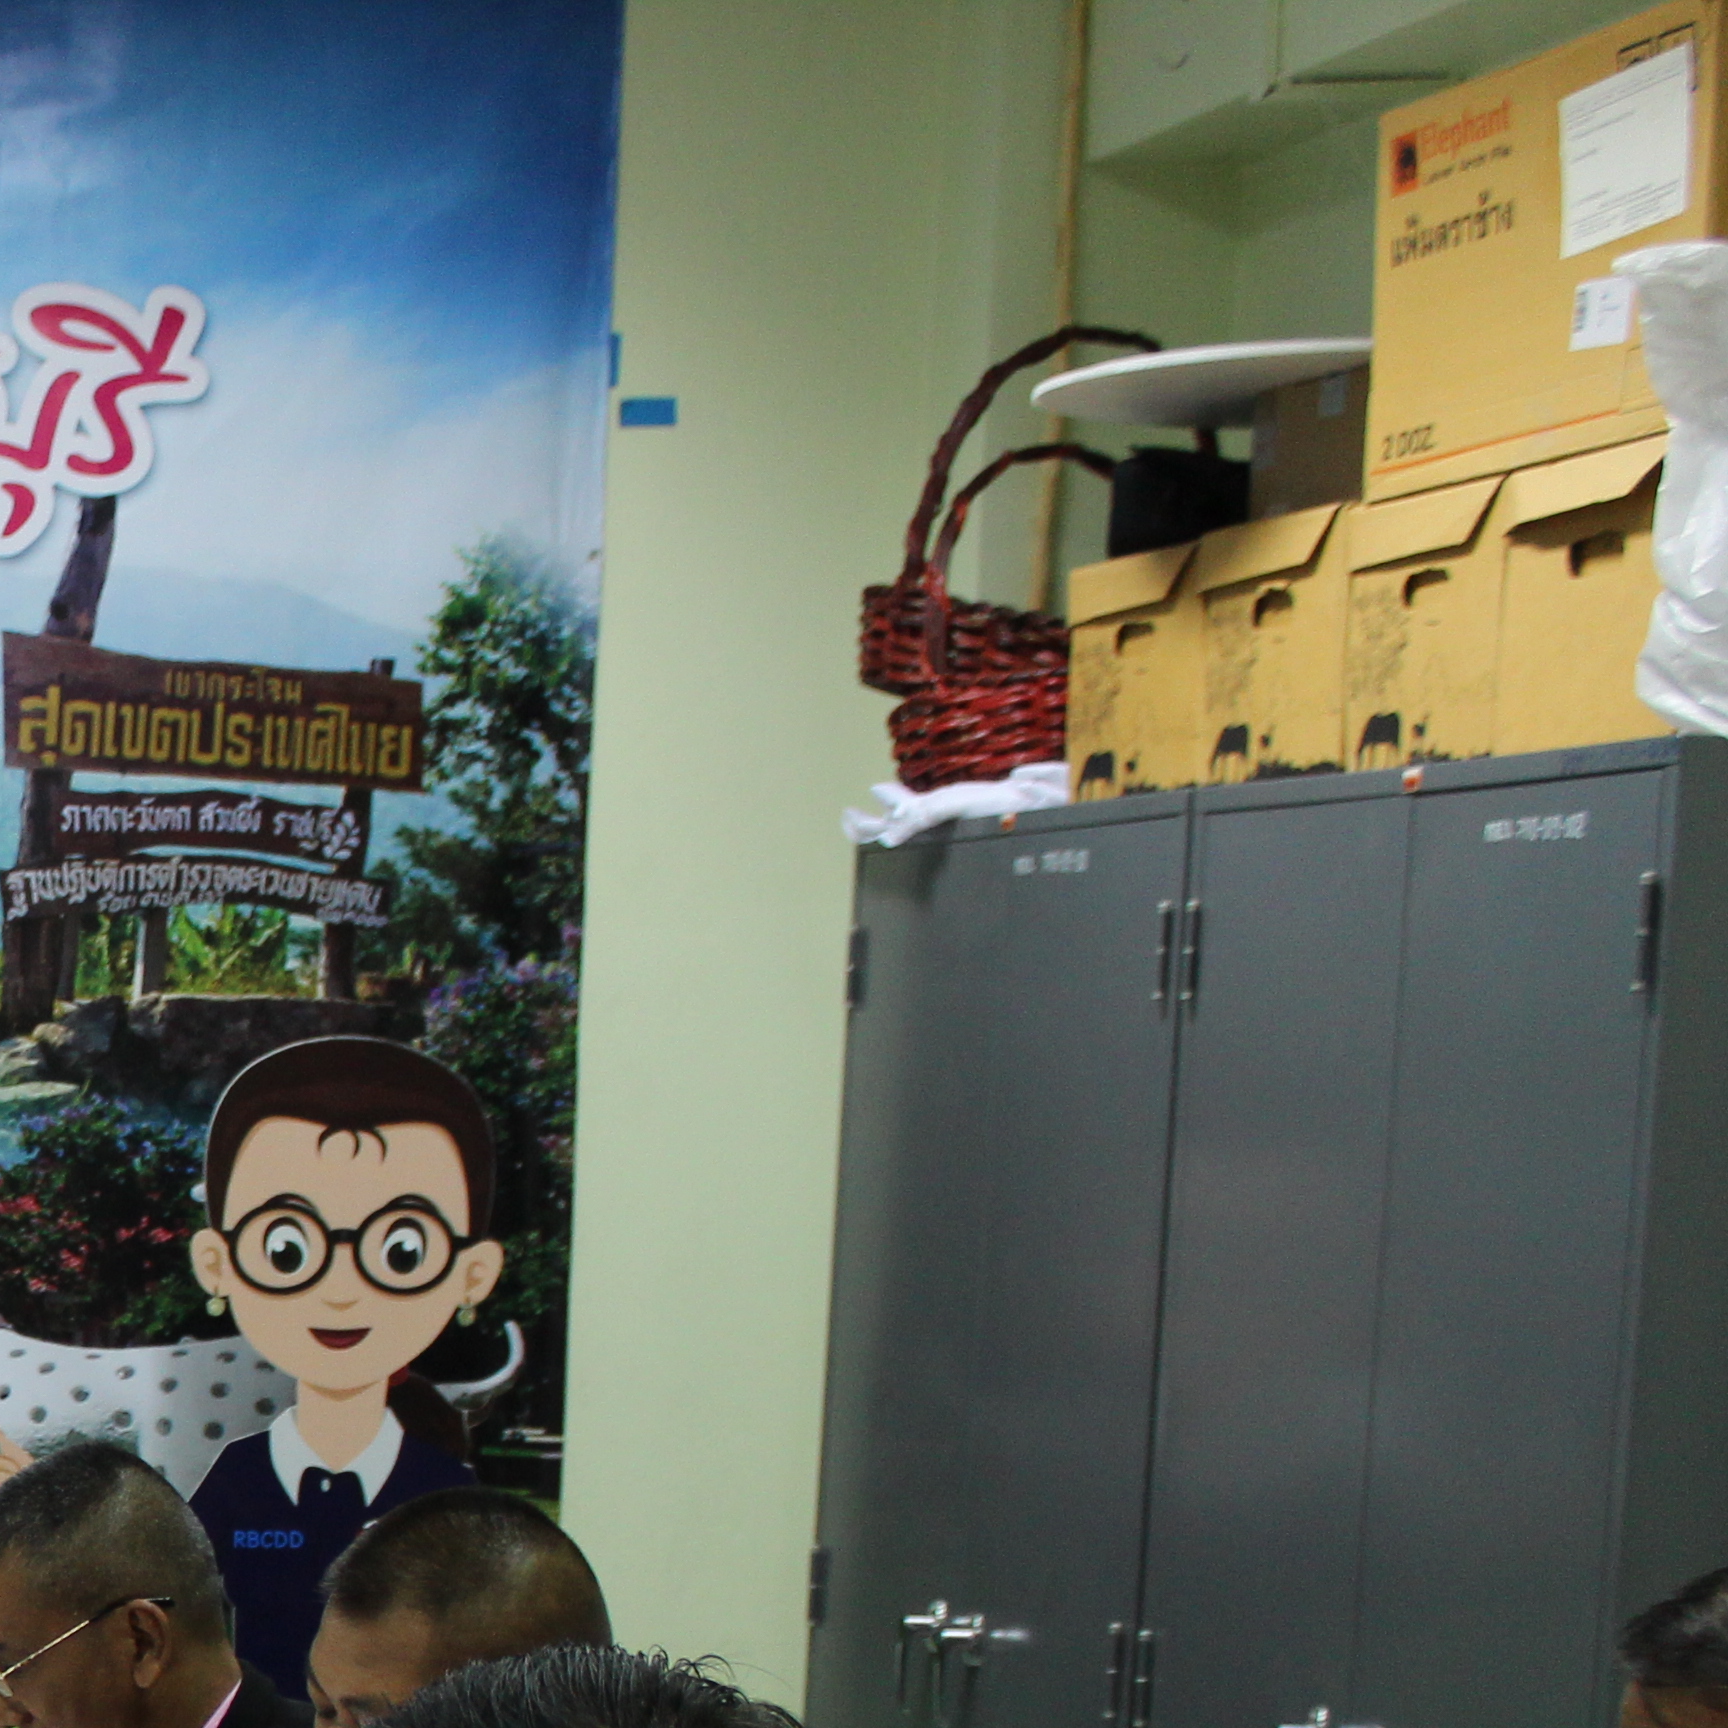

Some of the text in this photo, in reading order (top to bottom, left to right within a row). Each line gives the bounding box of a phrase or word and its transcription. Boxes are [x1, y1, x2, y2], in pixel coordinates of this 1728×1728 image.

[16, 684, 414, 779] สุดเขตประเทศไทย
[233, 1530, 305, 1548] RBCDD
